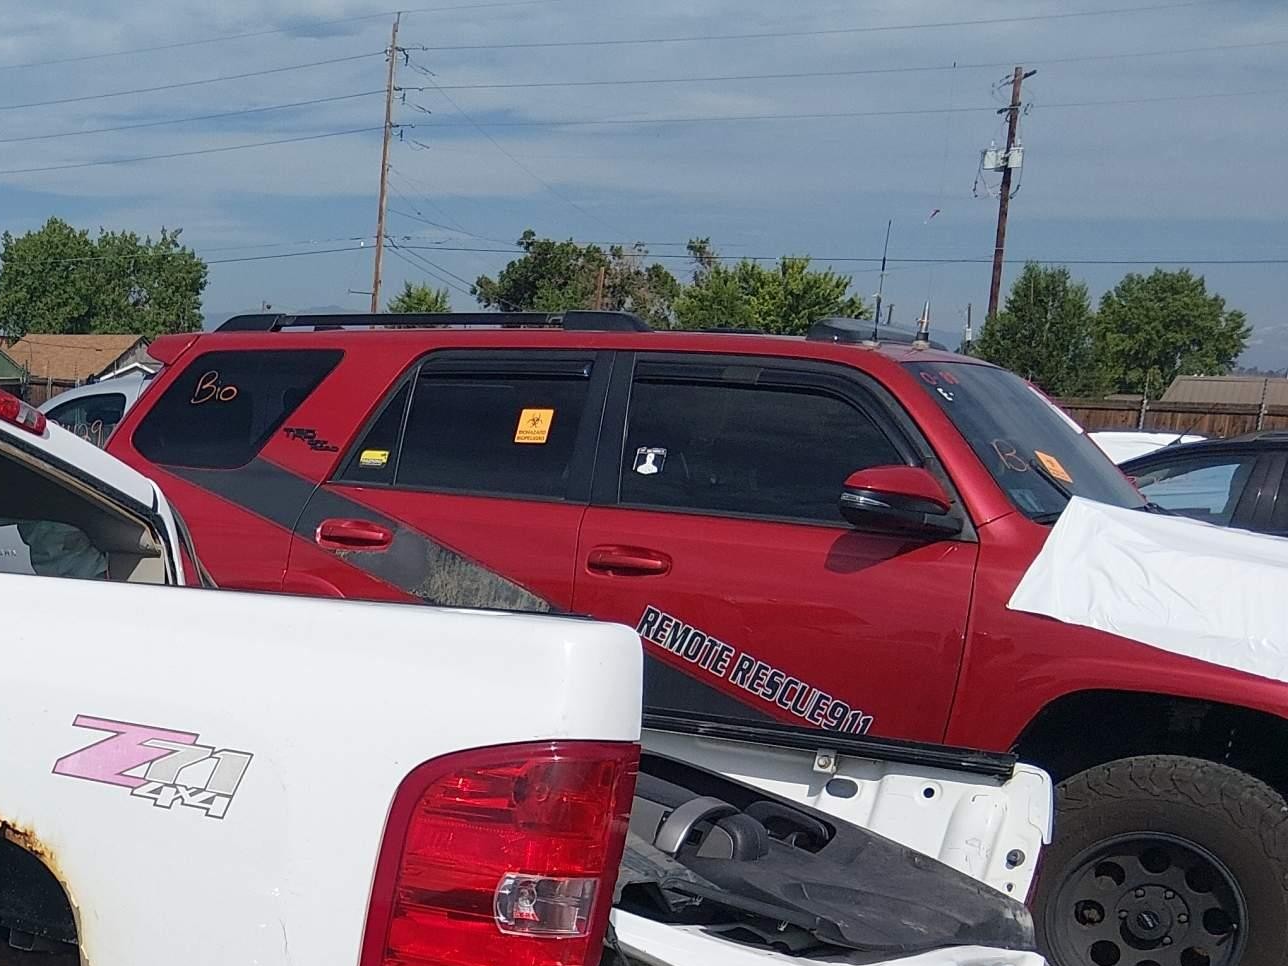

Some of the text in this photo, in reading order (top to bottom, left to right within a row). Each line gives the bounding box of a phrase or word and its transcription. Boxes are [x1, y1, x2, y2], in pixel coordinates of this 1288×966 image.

[191, 370, 238, 404] Bio
[283, 427, 316, 442] TRD
[637, 605, 874, 735] REMOTE RESCUE911
[51, 714, 254, 797] Z71
